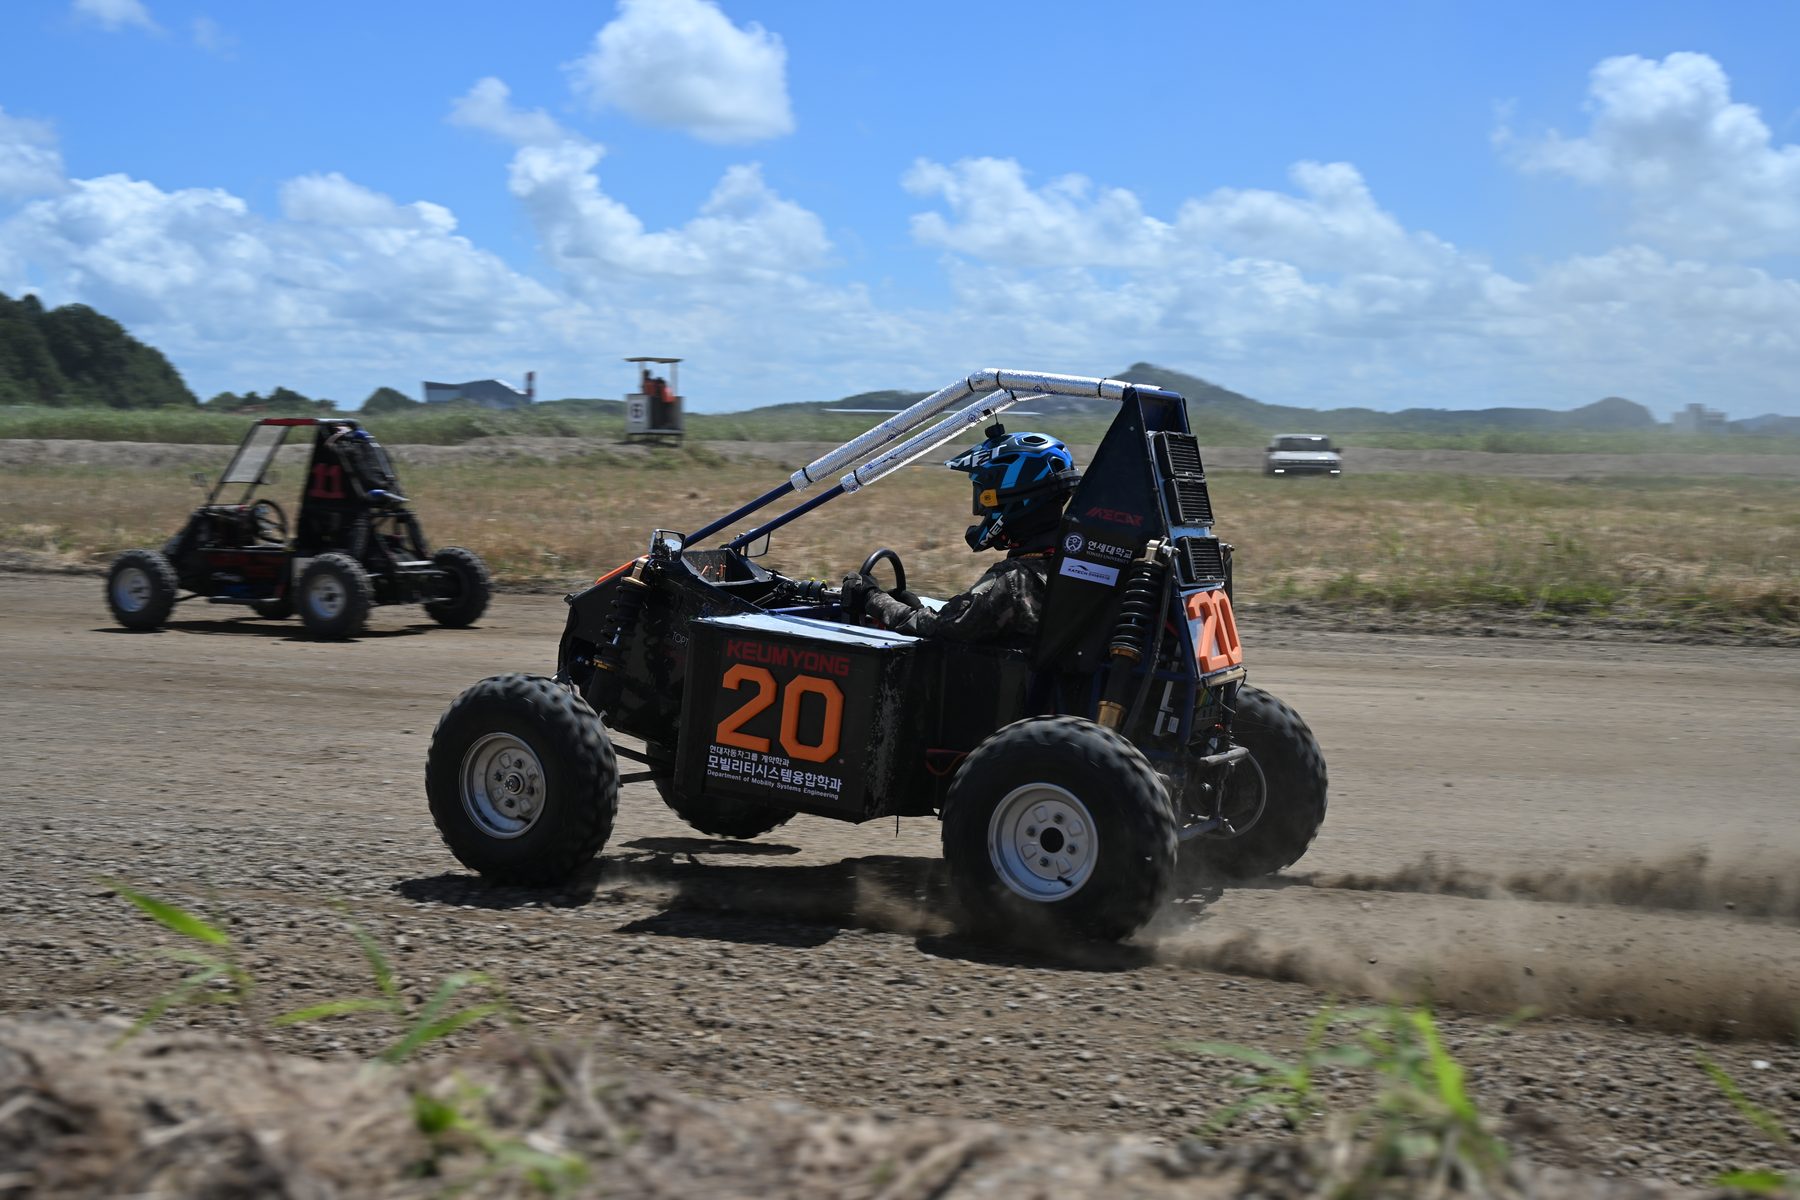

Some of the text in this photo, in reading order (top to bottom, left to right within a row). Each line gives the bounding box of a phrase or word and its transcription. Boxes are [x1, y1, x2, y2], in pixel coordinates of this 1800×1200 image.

[945, 444, 1007, 468] MET
[980, 515, 1004, 545] MET
[1088, 541, 1133, 559] 연세대학교
[1186, 589, 1243, 673] 20
[727, 639, 849, 677] KEUMYONG
[715, 663, 845, 763] 20
[707, 755, 842, 792] 모빌리티시스템융합학과
[761, 754, 790, 767] 계약학과
[707, 769, 741, 781] Department
[751, 778, 775, 788] Mobility
[776, 782, 801, 793] Systems
[803, 788, 839, 800] Engineering
